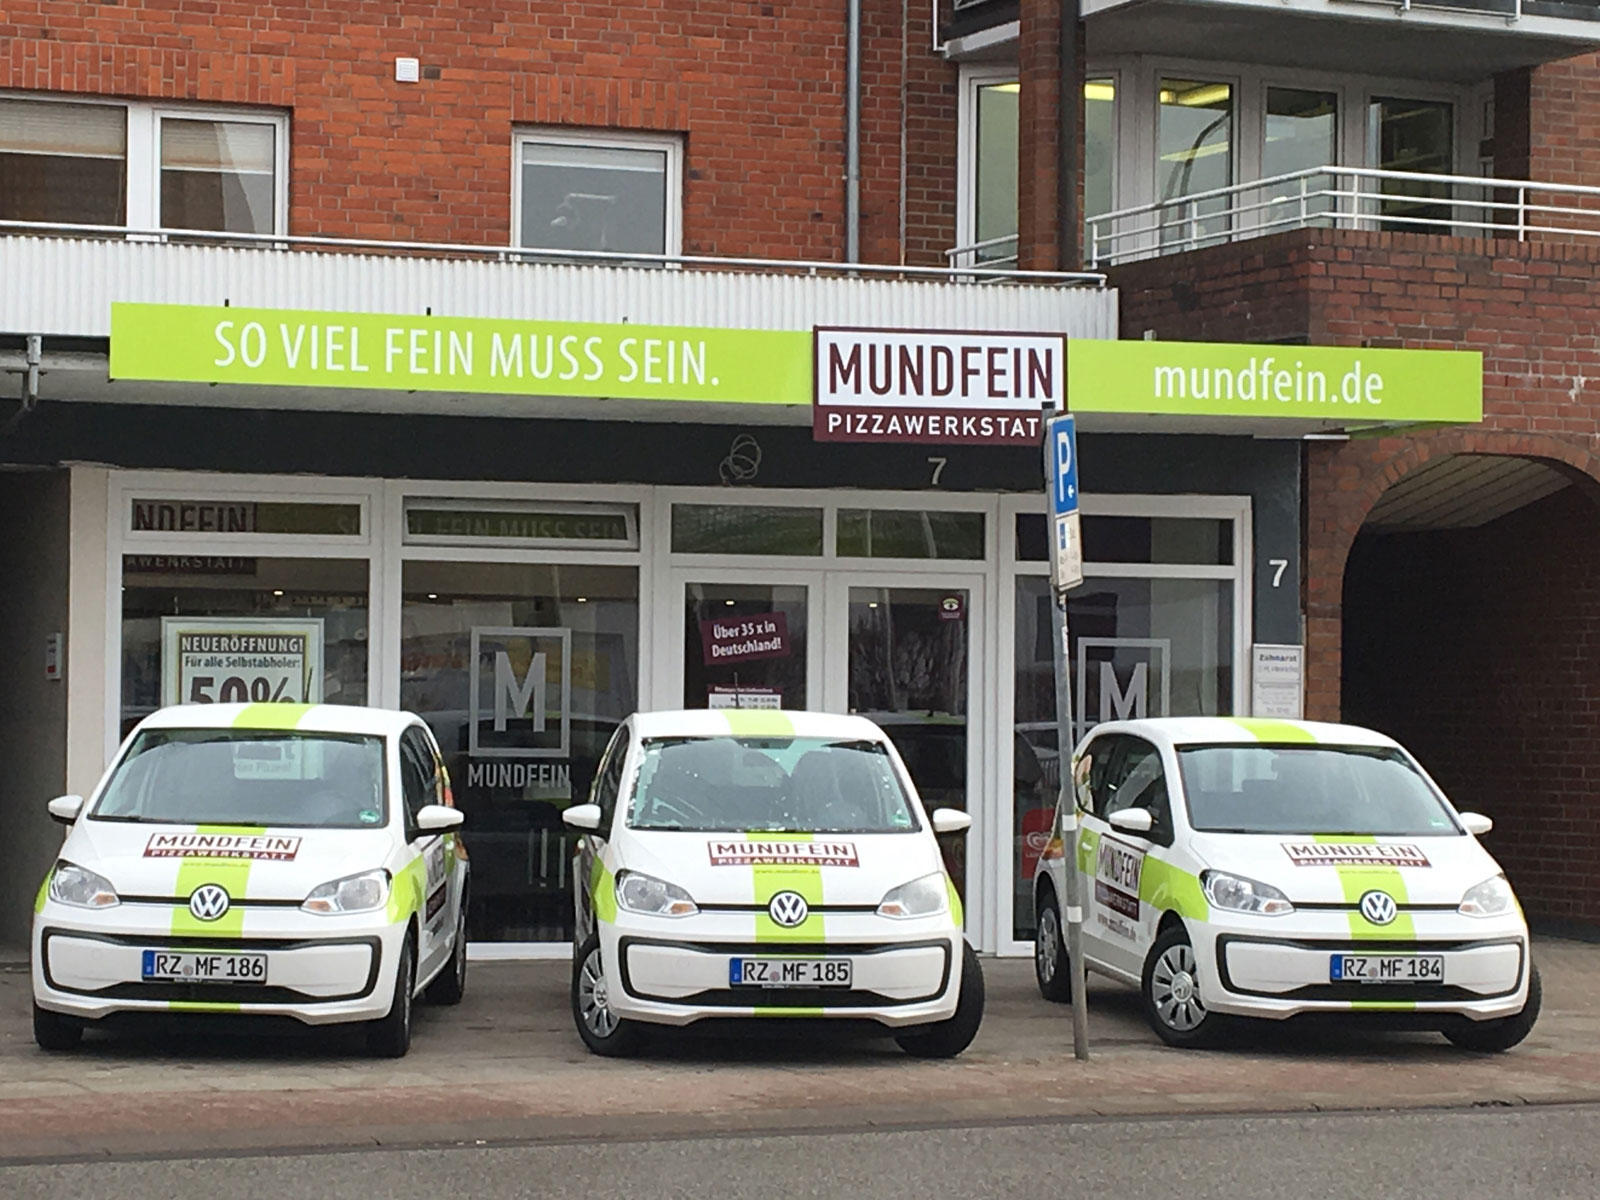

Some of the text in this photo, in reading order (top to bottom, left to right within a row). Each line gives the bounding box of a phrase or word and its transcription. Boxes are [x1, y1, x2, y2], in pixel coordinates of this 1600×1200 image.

[213, 320, 720, 387] SO VIEL FEIN MUSS SEIN.
[827, 341, 1054, 399] MUNDFEIN
[1153, 356, 1384, 405] mundfein.de
[827, 413, 1040, 438] PIZZAWERKSTAT
[927, 457, 948, 485] 7
[1056, 431, 1072, 503] P
[1268, 559, 1289, 587] 7
[713, 620, 776, 639] Über 35 x in
[181, 635, 304, 653] NEUERÖFFNUNG!
[711, 637, 782, 657] Deutschland!
[185, 656, 202, 668] Für
[204, 656, 224, 668] alle
[190, 676, 296, 704] 50%
[494, 651, 547, 733] M
[1100, 661, 1148, 720] M
[467, 763, 571, 788] MUNDFEIN
[156, 835, 293, 851] MUNDFEIN
[716, 842, 849, 857] MUNDFEIN
[1290, 844, 1418, 858] MUNDFEIN
[150, 849, 289, 861] PIZZAWERKSTATT
[717, 856, 851, 866] PIZZAWERKSTATT
[156, 954, 263, 977] RZ MF 186
[743, 962, 849, 982] RZ MF 185
[1343, 958, 1441, 978] RZ MF 184
